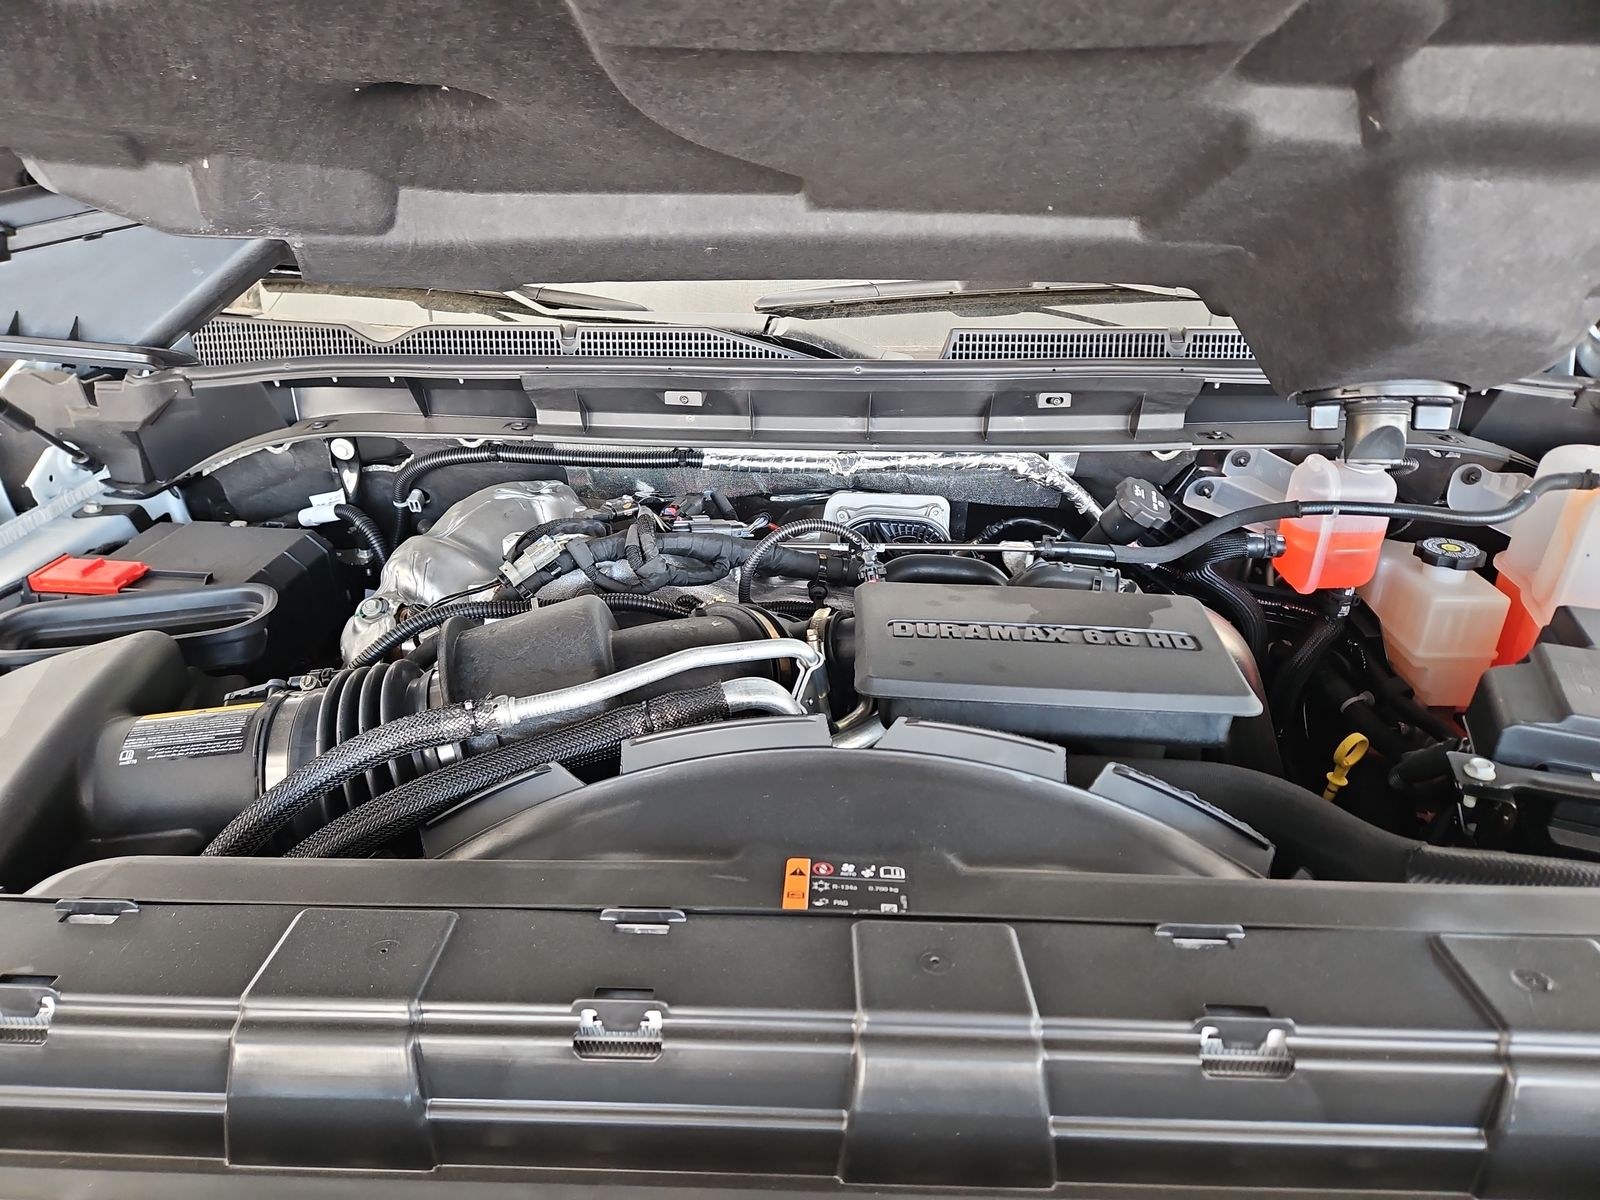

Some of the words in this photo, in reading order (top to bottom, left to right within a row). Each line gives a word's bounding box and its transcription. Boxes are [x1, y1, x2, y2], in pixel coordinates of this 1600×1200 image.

[893, 622, 1069, 643] DURAMAX
[1083, 629, 1139, 646] 6.6
[1146, 632, 1196, 650] HD
